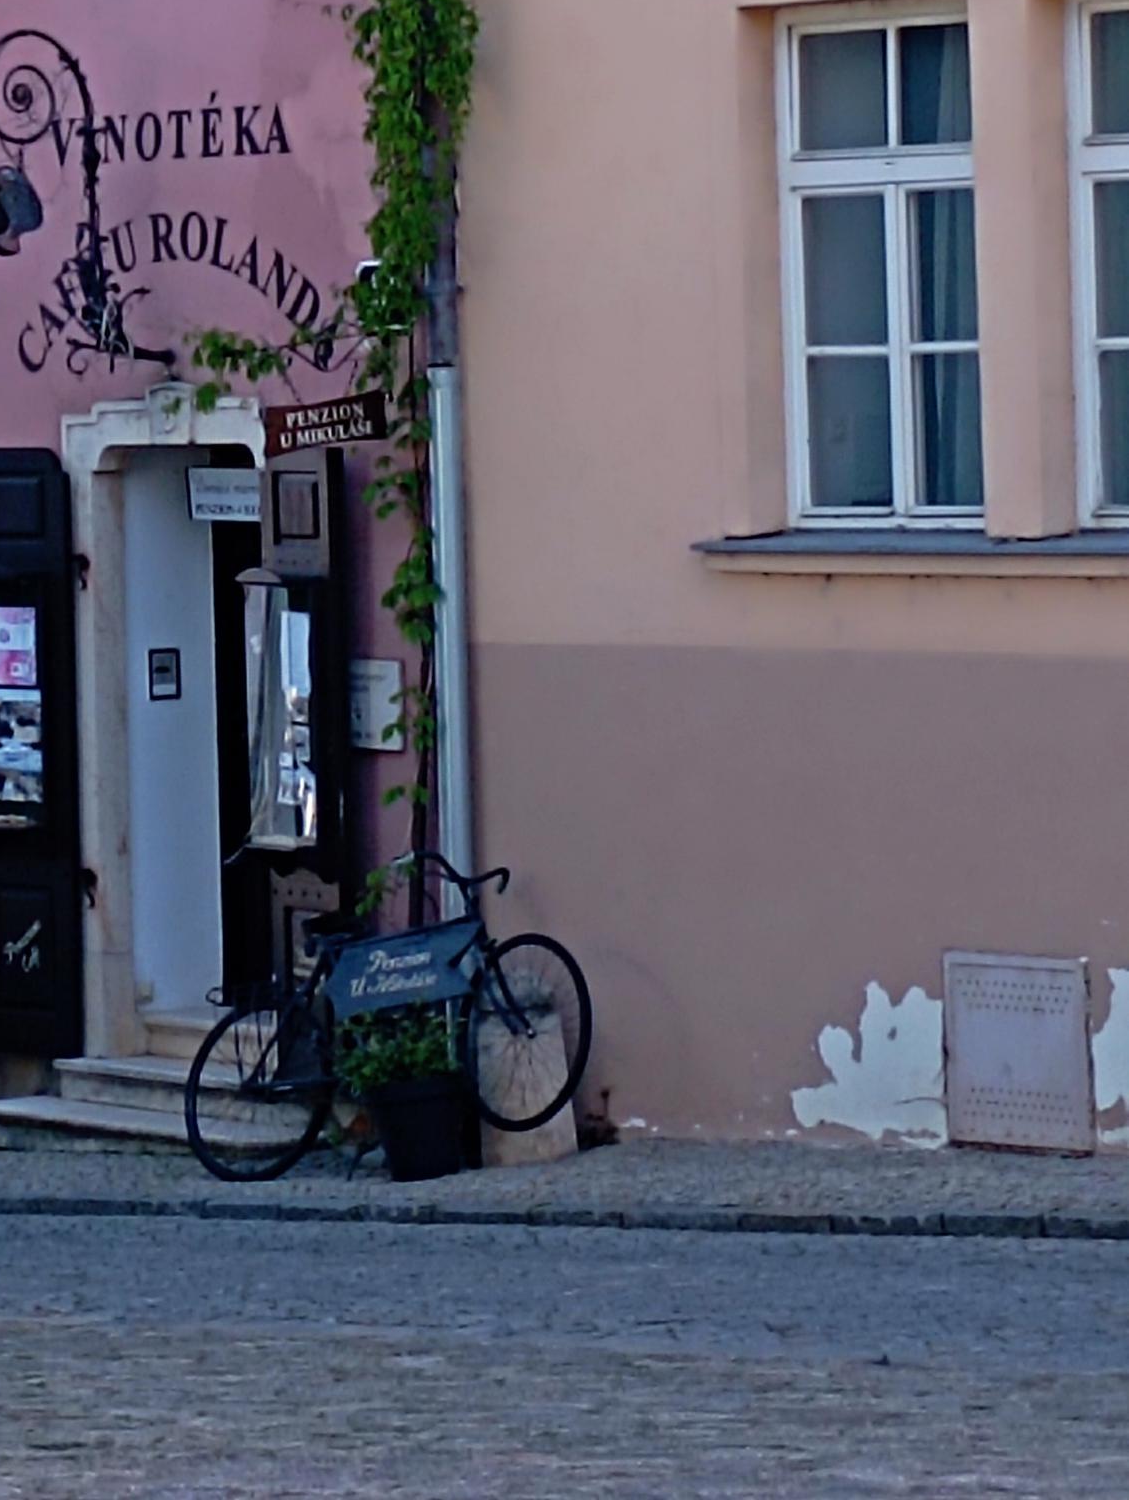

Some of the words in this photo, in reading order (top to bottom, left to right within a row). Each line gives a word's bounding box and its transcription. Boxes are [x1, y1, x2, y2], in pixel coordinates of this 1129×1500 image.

[51, 90, 292, 168] VNOTÉKA
[108, 220, 137, 273] U
[149, 210, 334, 368] ROLAND
[279, 431, 293, 449] U
[285, 401, 365, 429] PENZION
